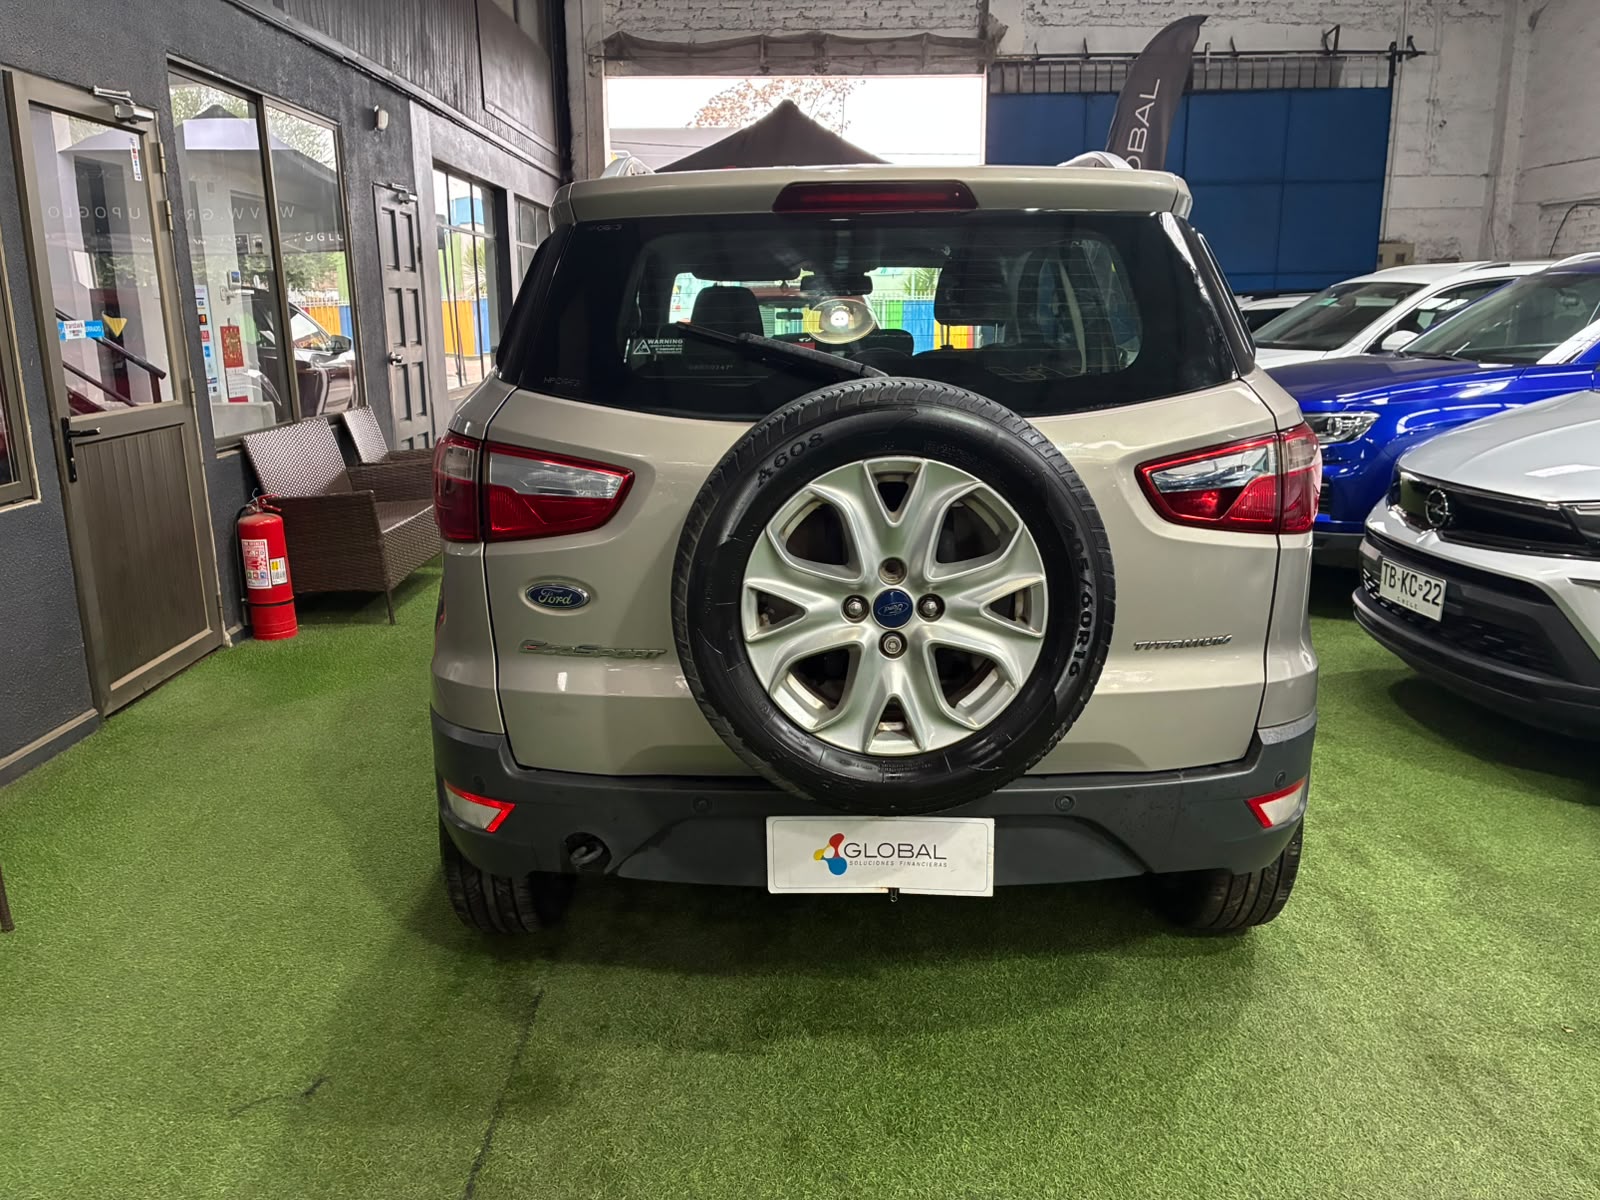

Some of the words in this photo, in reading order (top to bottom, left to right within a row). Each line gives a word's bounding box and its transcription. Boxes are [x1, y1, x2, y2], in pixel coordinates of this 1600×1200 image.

[757, 432, 824, 488] A608
[537, 588, 573, 605] Ford
[1134, 633, 1233, 651] TITANIUM
[843, 842, 947, 860] GLOBAL
